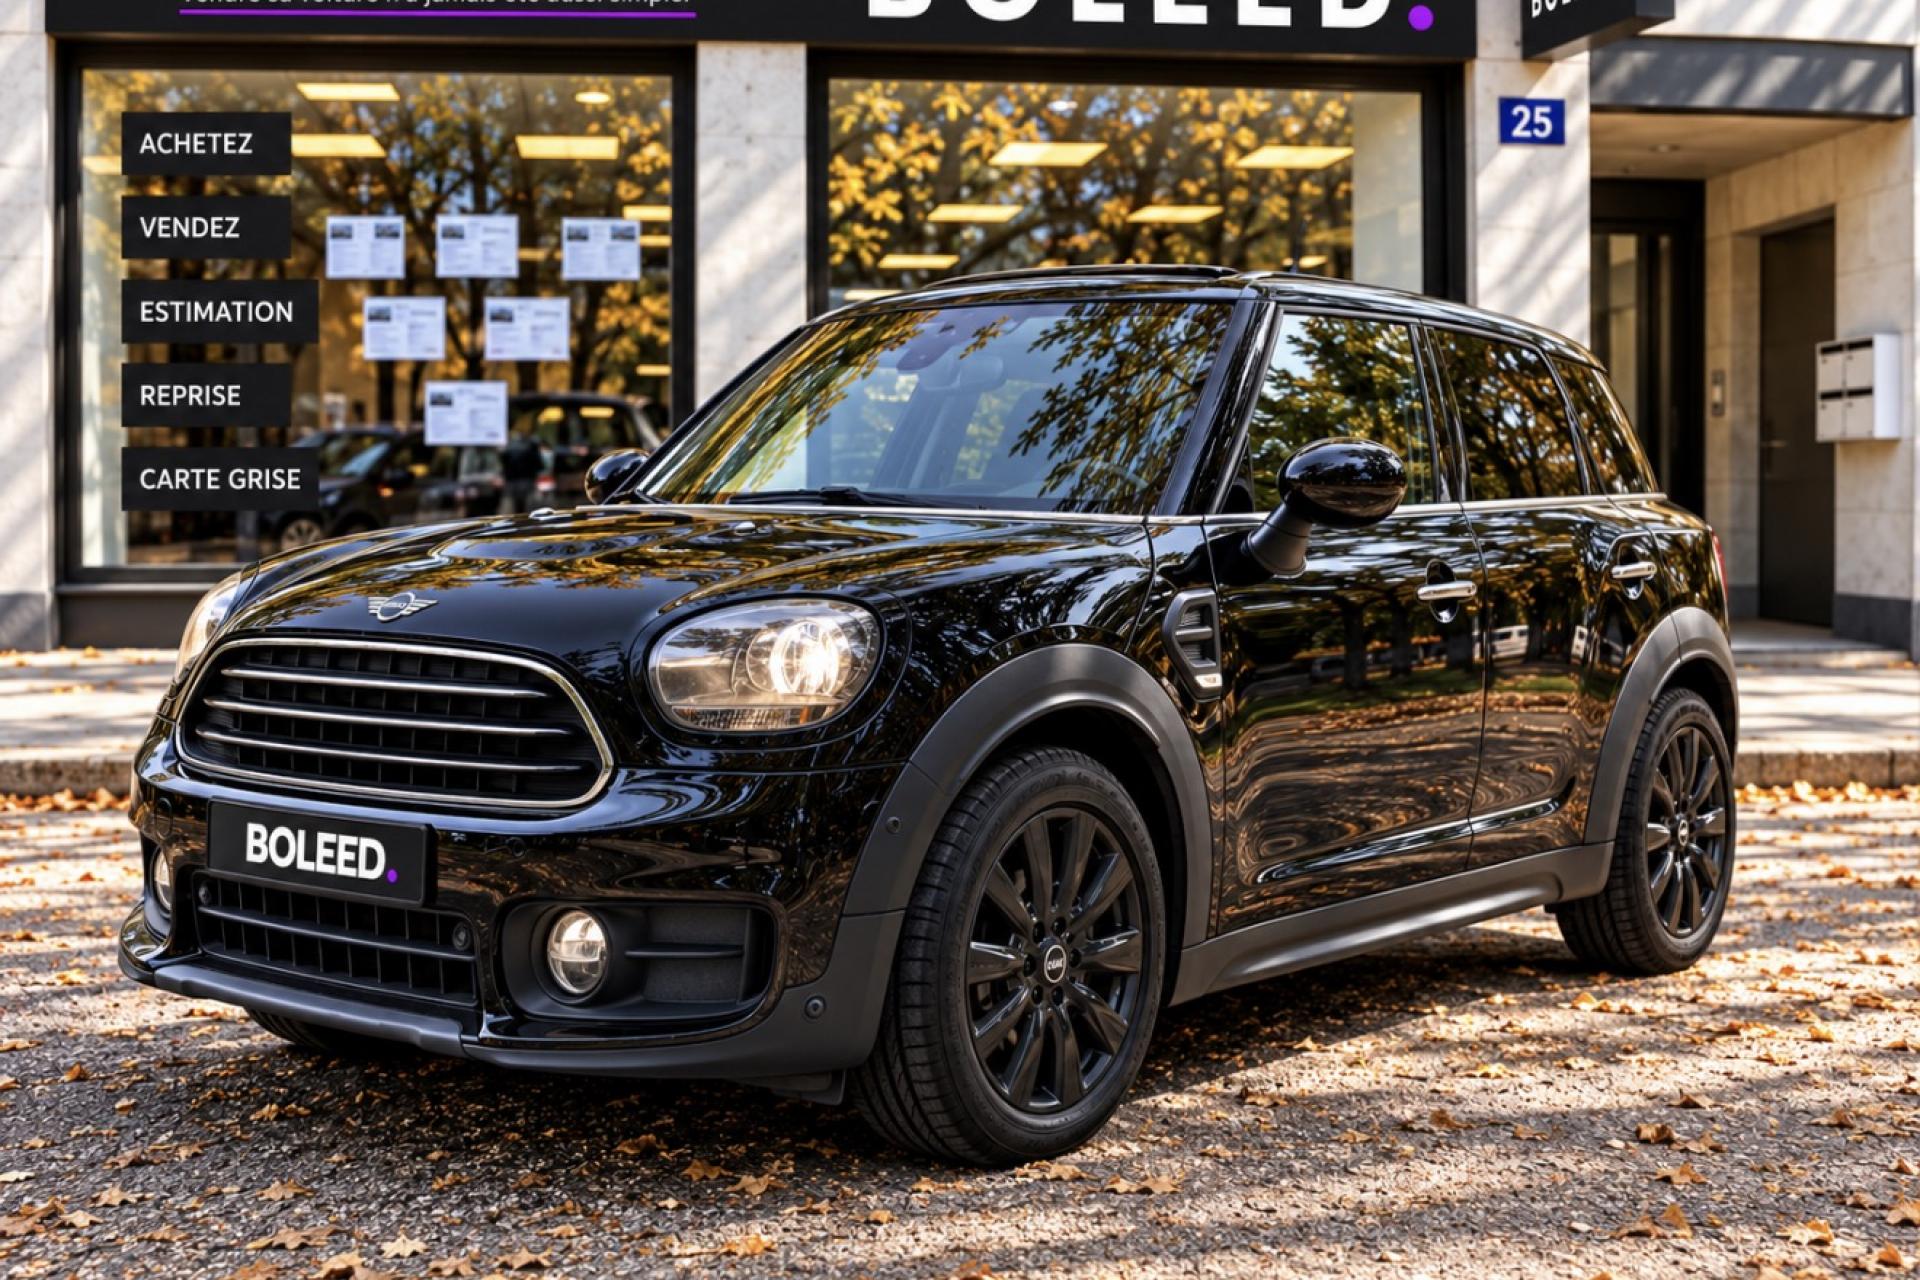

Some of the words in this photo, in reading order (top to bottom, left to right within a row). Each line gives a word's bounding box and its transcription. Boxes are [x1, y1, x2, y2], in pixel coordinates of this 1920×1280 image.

[1511, 105, 1553, 138] 25
[139, 132, 253, 154] ACHETEZ
[139, 216, 240, 238] VENDEZ
[140, 300, 293, 323] ESTIMATION
[140, 384, 241, 406] REPRISE
[140, 468, 220, 490] CARTE
[228, 468, 301, 490] GRISE
